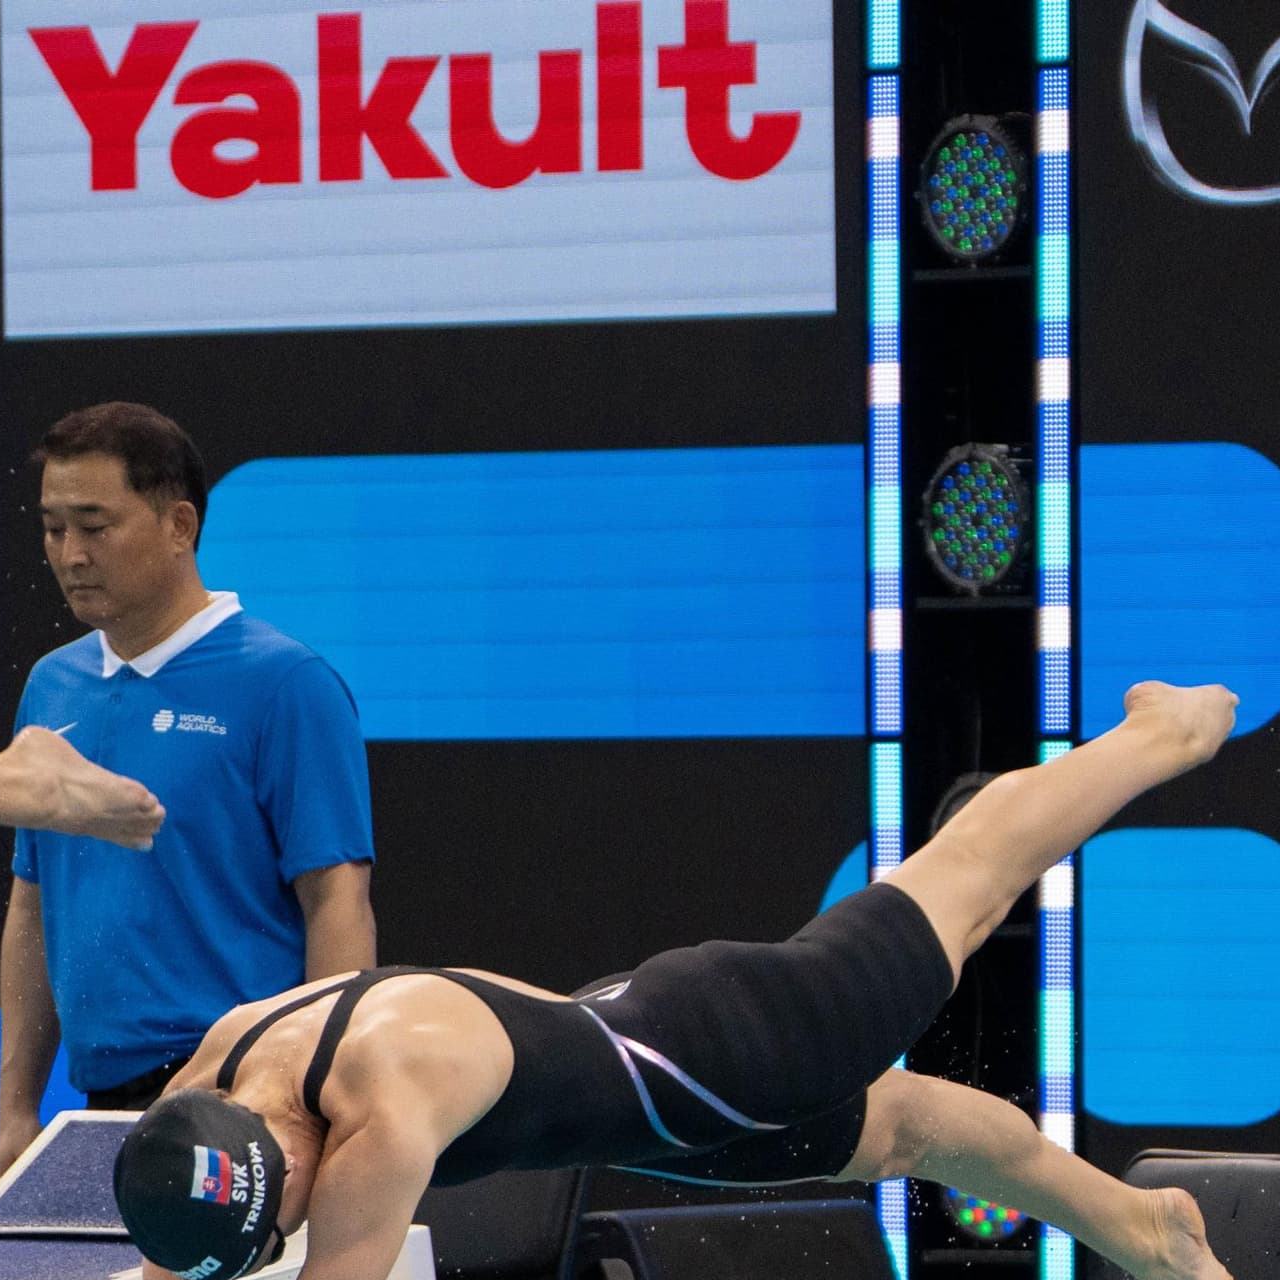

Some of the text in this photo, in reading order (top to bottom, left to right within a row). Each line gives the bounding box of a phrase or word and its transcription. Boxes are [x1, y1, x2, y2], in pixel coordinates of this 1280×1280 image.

[28, 0, 802, 199] Yakult
[176, 721, 228, 735] AQUATICS
[179, 714, 217, 725] WORLD
[232, 1161, 249, 1203] SVK
